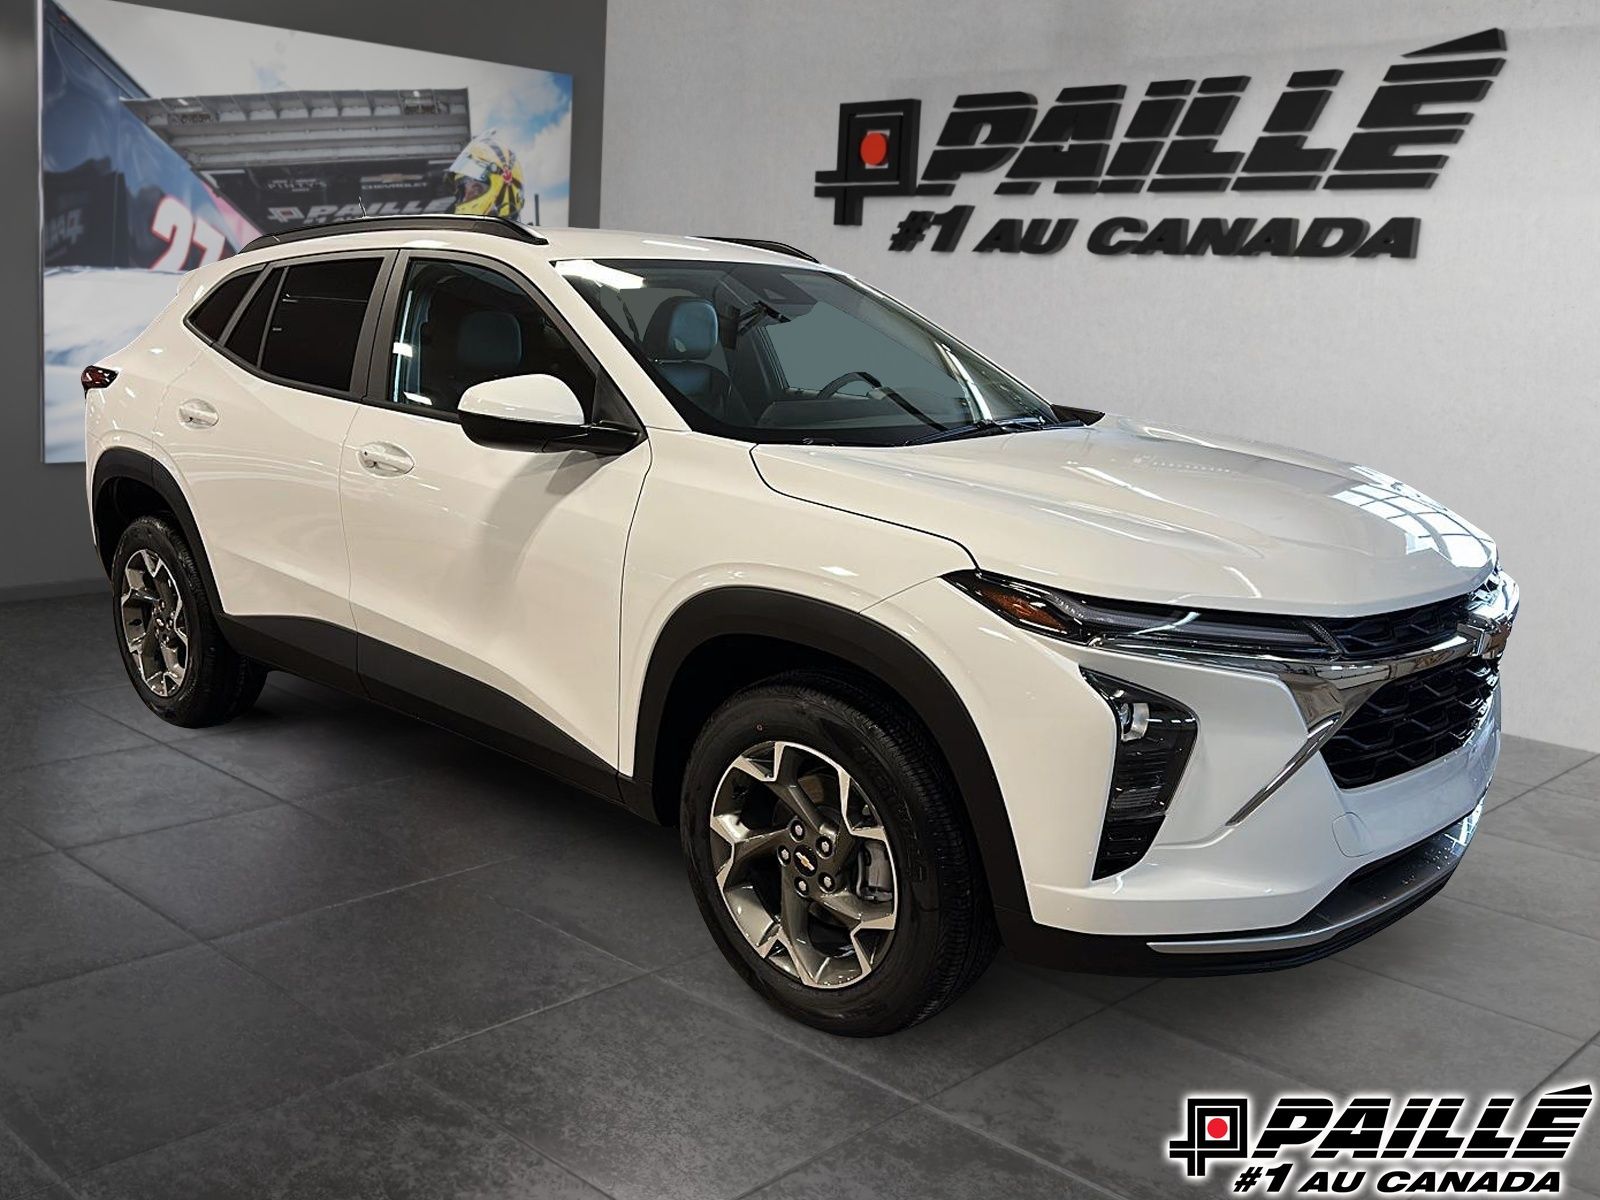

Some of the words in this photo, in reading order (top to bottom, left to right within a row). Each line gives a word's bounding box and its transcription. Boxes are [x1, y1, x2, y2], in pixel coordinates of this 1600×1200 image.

[917, 28, 1507, 196] PAILLÉ
[150, 196, 226, 272] 27
[889, 205, 975, 252] #1
[975, 217, 1079, 254] AU
[1087, 216, 1421, 259] CANADA
